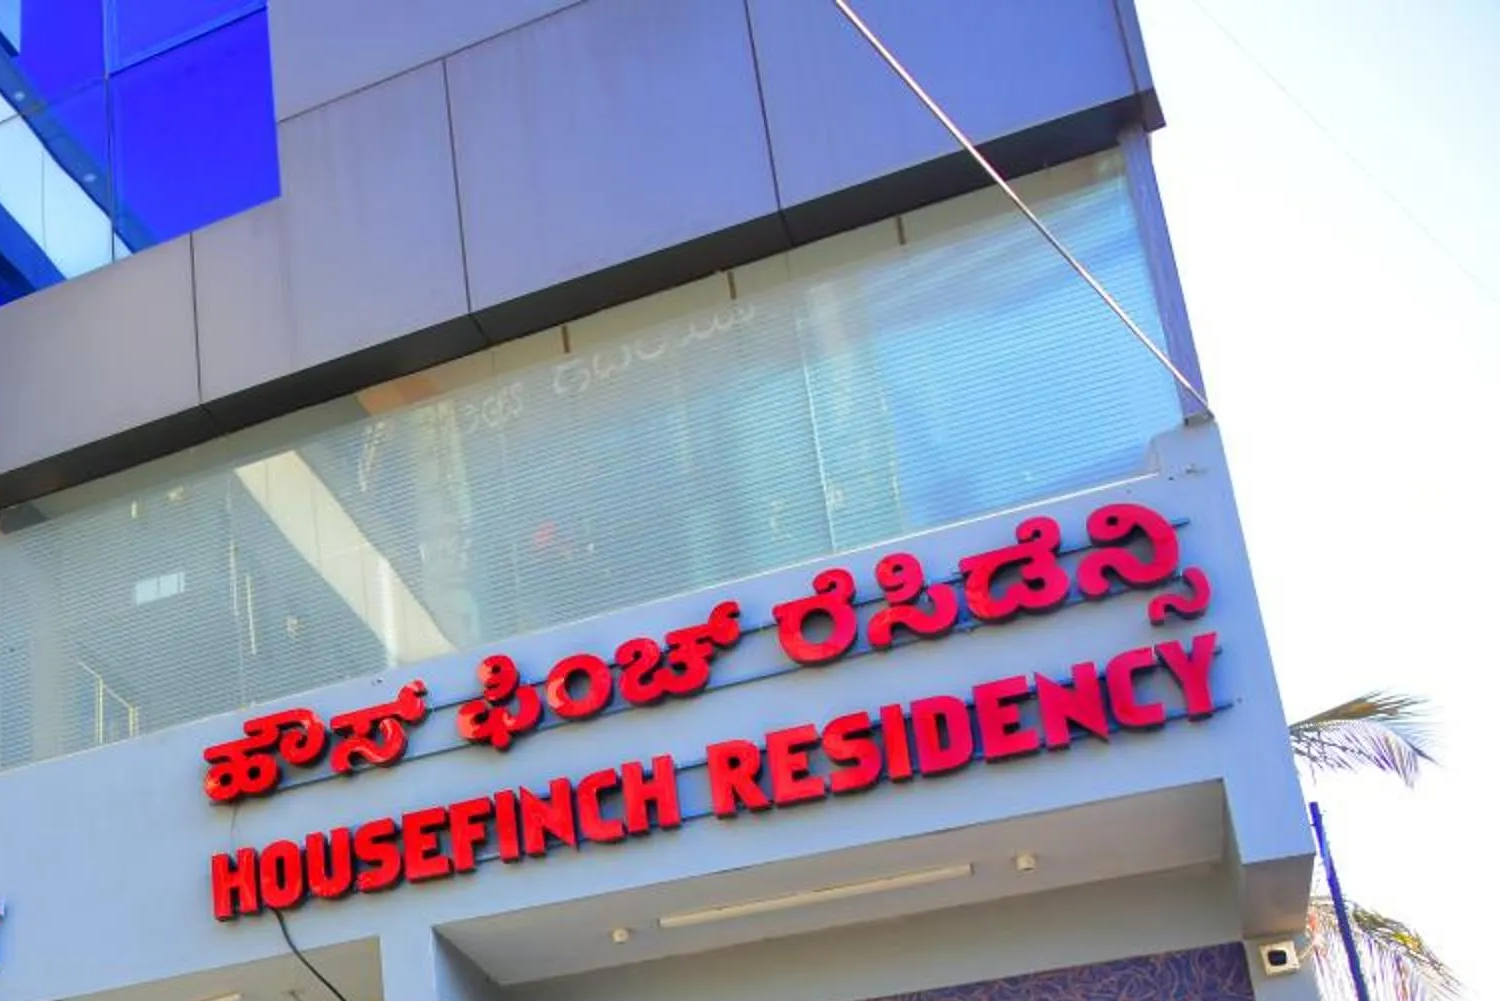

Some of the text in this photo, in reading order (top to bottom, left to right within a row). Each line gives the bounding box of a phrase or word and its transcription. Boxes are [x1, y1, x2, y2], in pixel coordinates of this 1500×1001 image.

[203, 680, 426, 801] ಹೌಸ್
[211, 632, 1219, 920] HOUSEFINCH RESIDENCY
